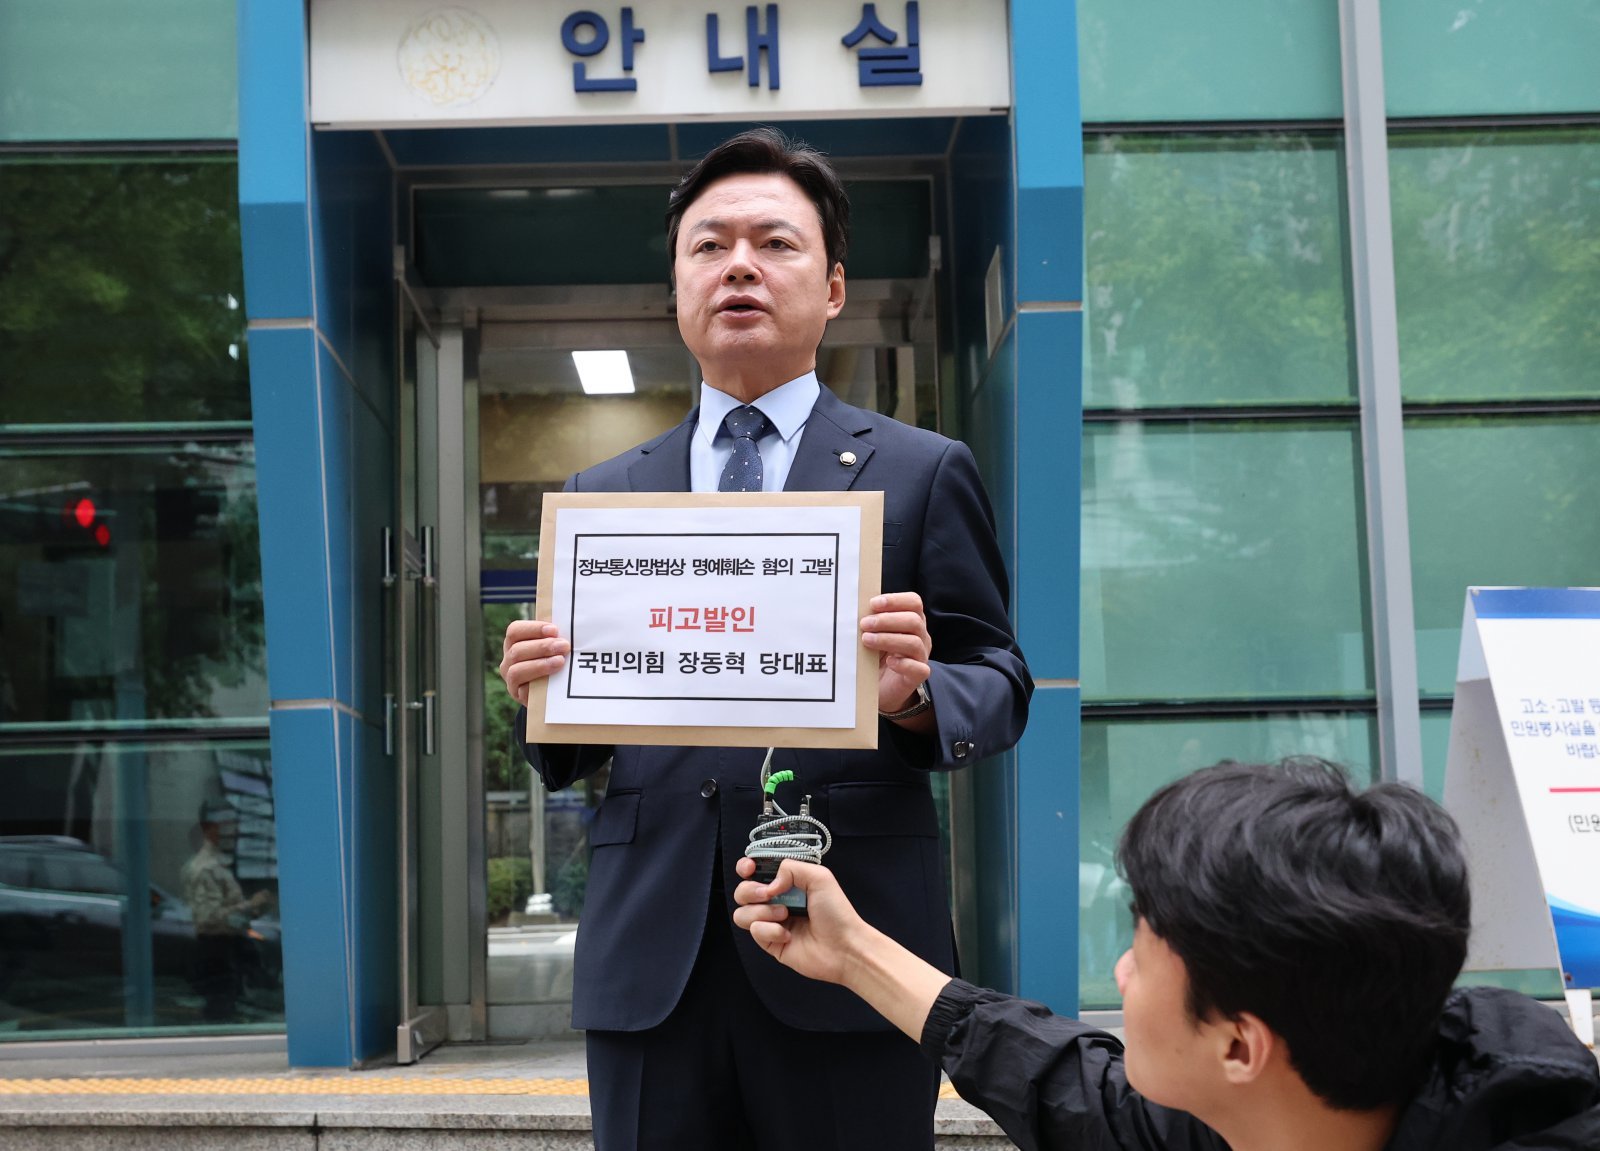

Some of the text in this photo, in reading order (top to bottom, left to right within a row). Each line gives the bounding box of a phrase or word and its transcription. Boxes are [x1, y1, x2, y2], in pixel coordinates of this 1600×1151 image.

[560, 1, 922, 93] 안내실
[578, 558, 834, 576] 정보통신망법상 명예훼손 혐의 고발
[649, 606, 755, 632] 피고발인
[577, 651, 828, 675] 국민의힘 장동혁 당대표
